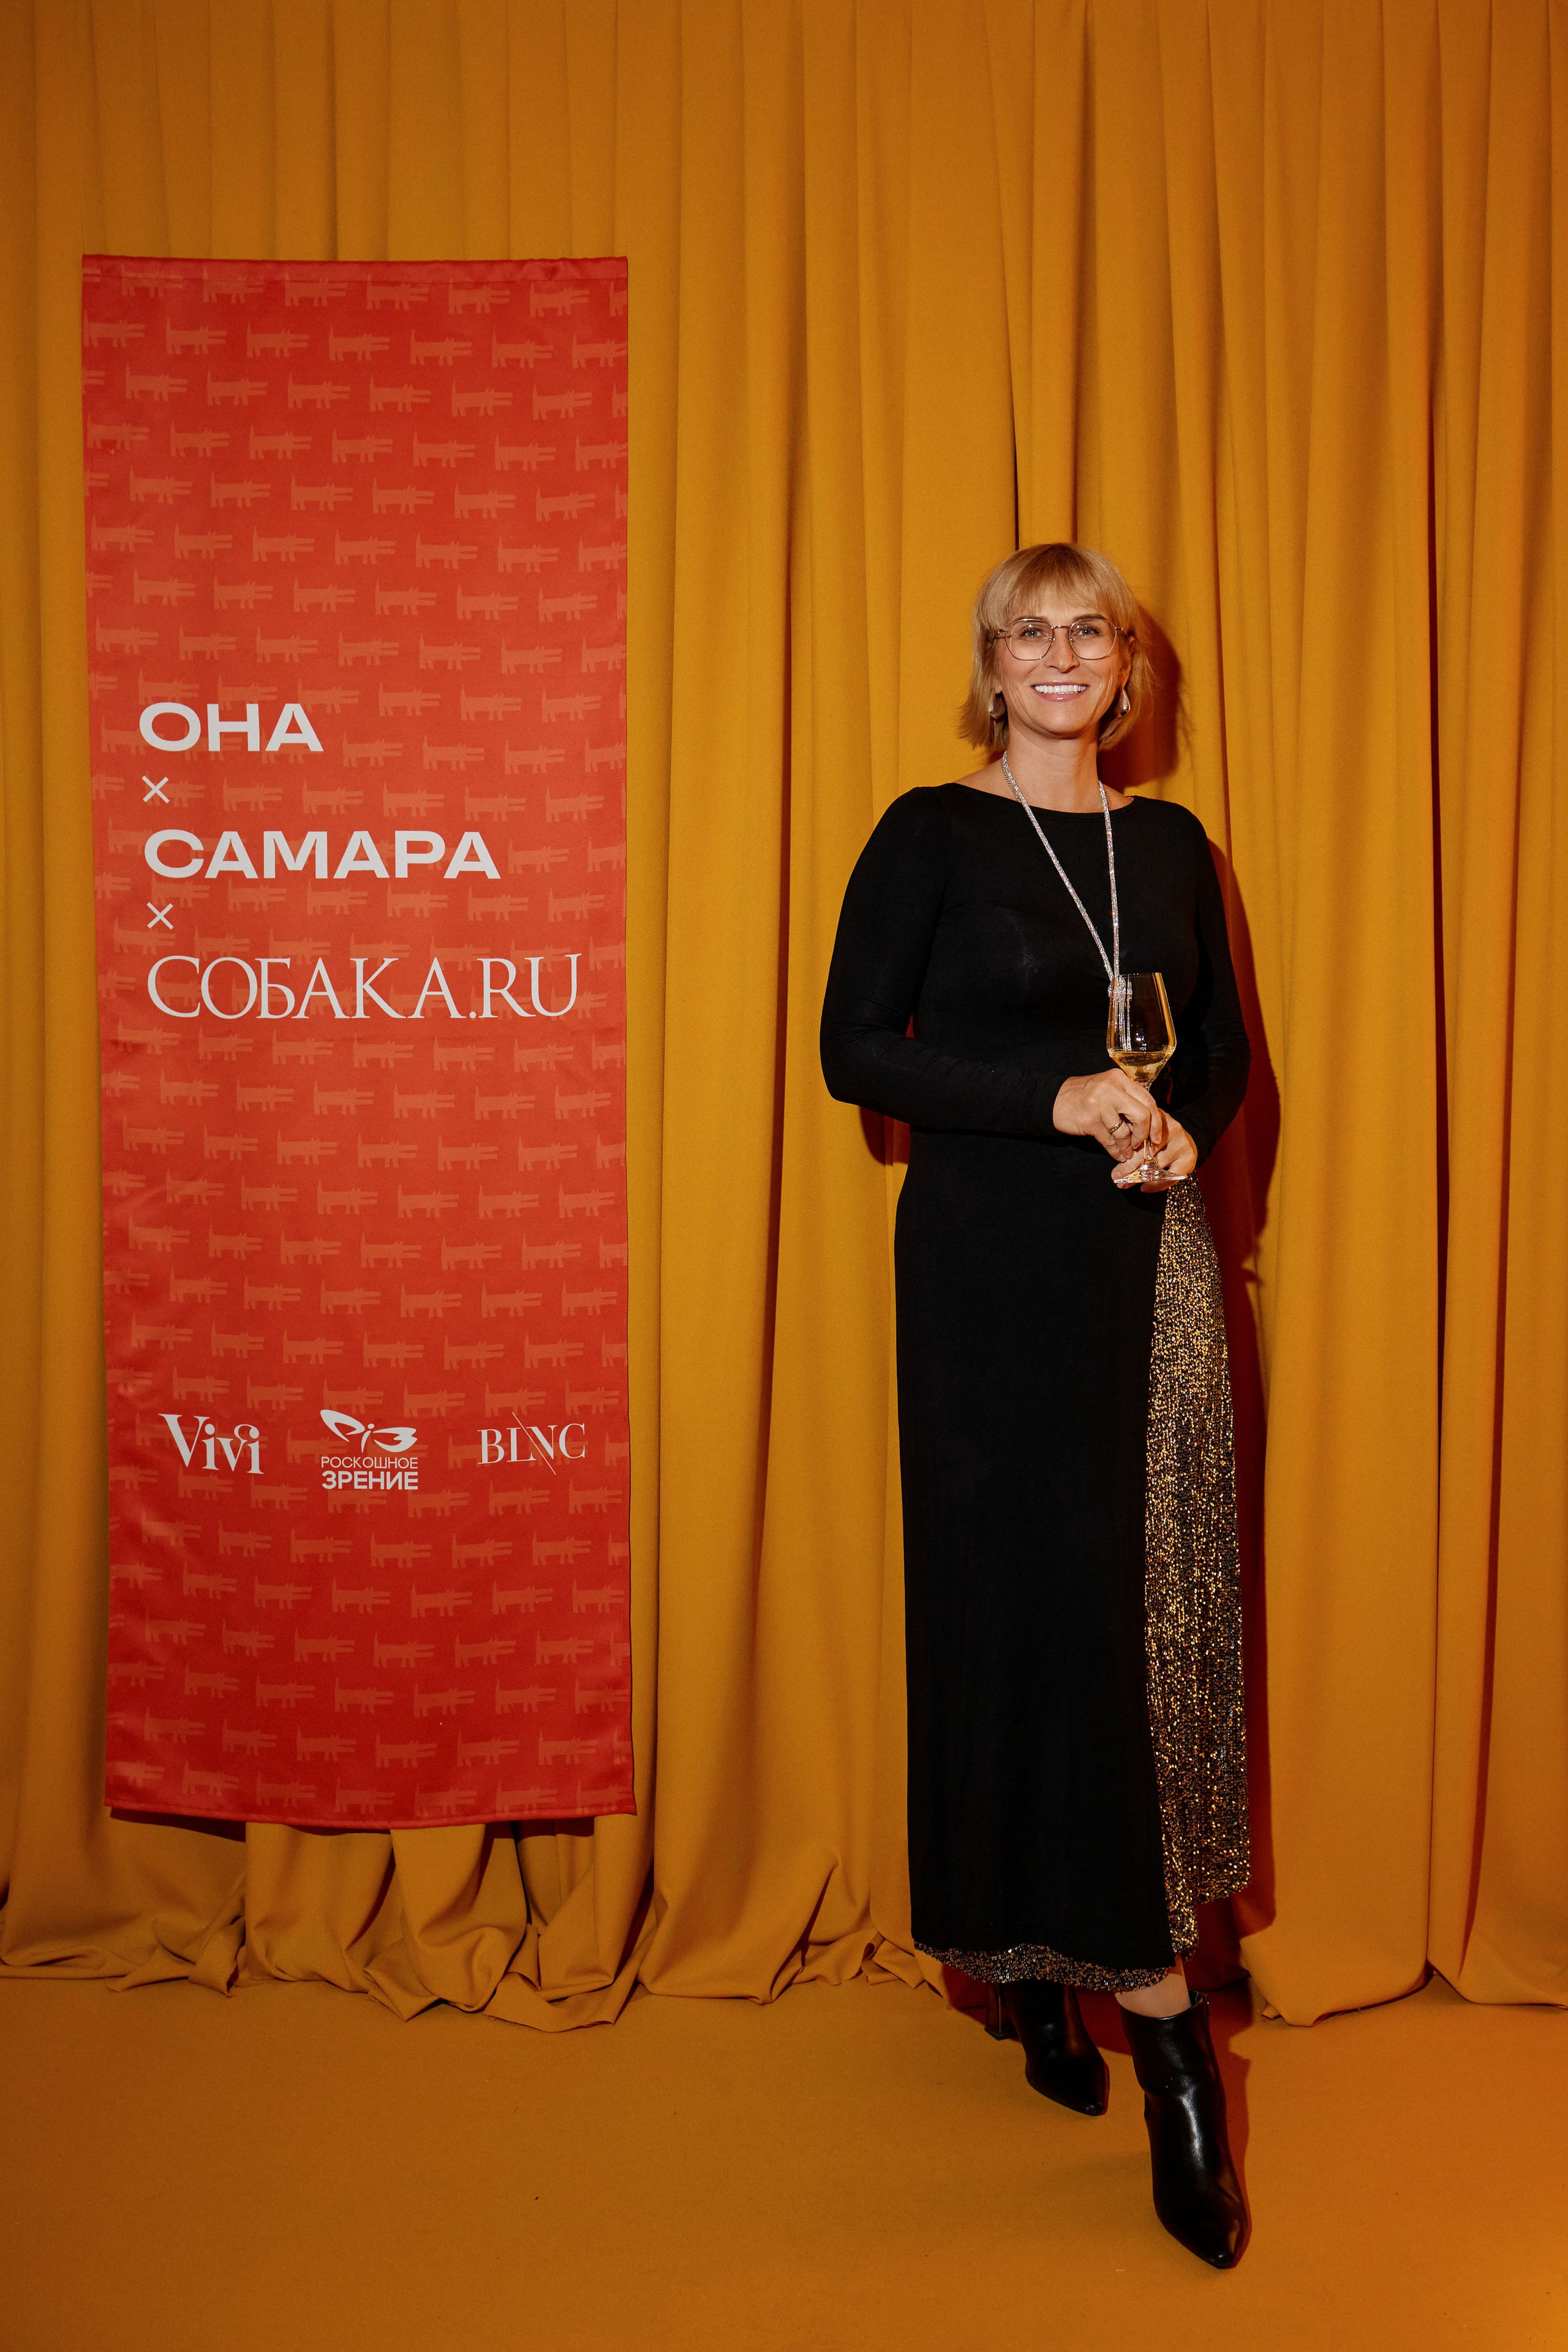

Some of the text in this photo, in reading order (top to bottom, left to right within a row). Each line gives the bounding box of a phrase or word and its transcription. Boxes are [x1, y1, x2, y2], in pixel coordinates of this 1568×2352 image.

[140, 701, 324, 752] ОНА
[144, 829, 501, 880] САМАРА
[147, 953, 582, 1019] СОБАКА.RU
[158, 1413, 264, 1474] Vivi
[322, 1457, 418, 1469] РОСКОШНОЕ
[322, 1471, 418, 1490] ЗРЕНИЕ
